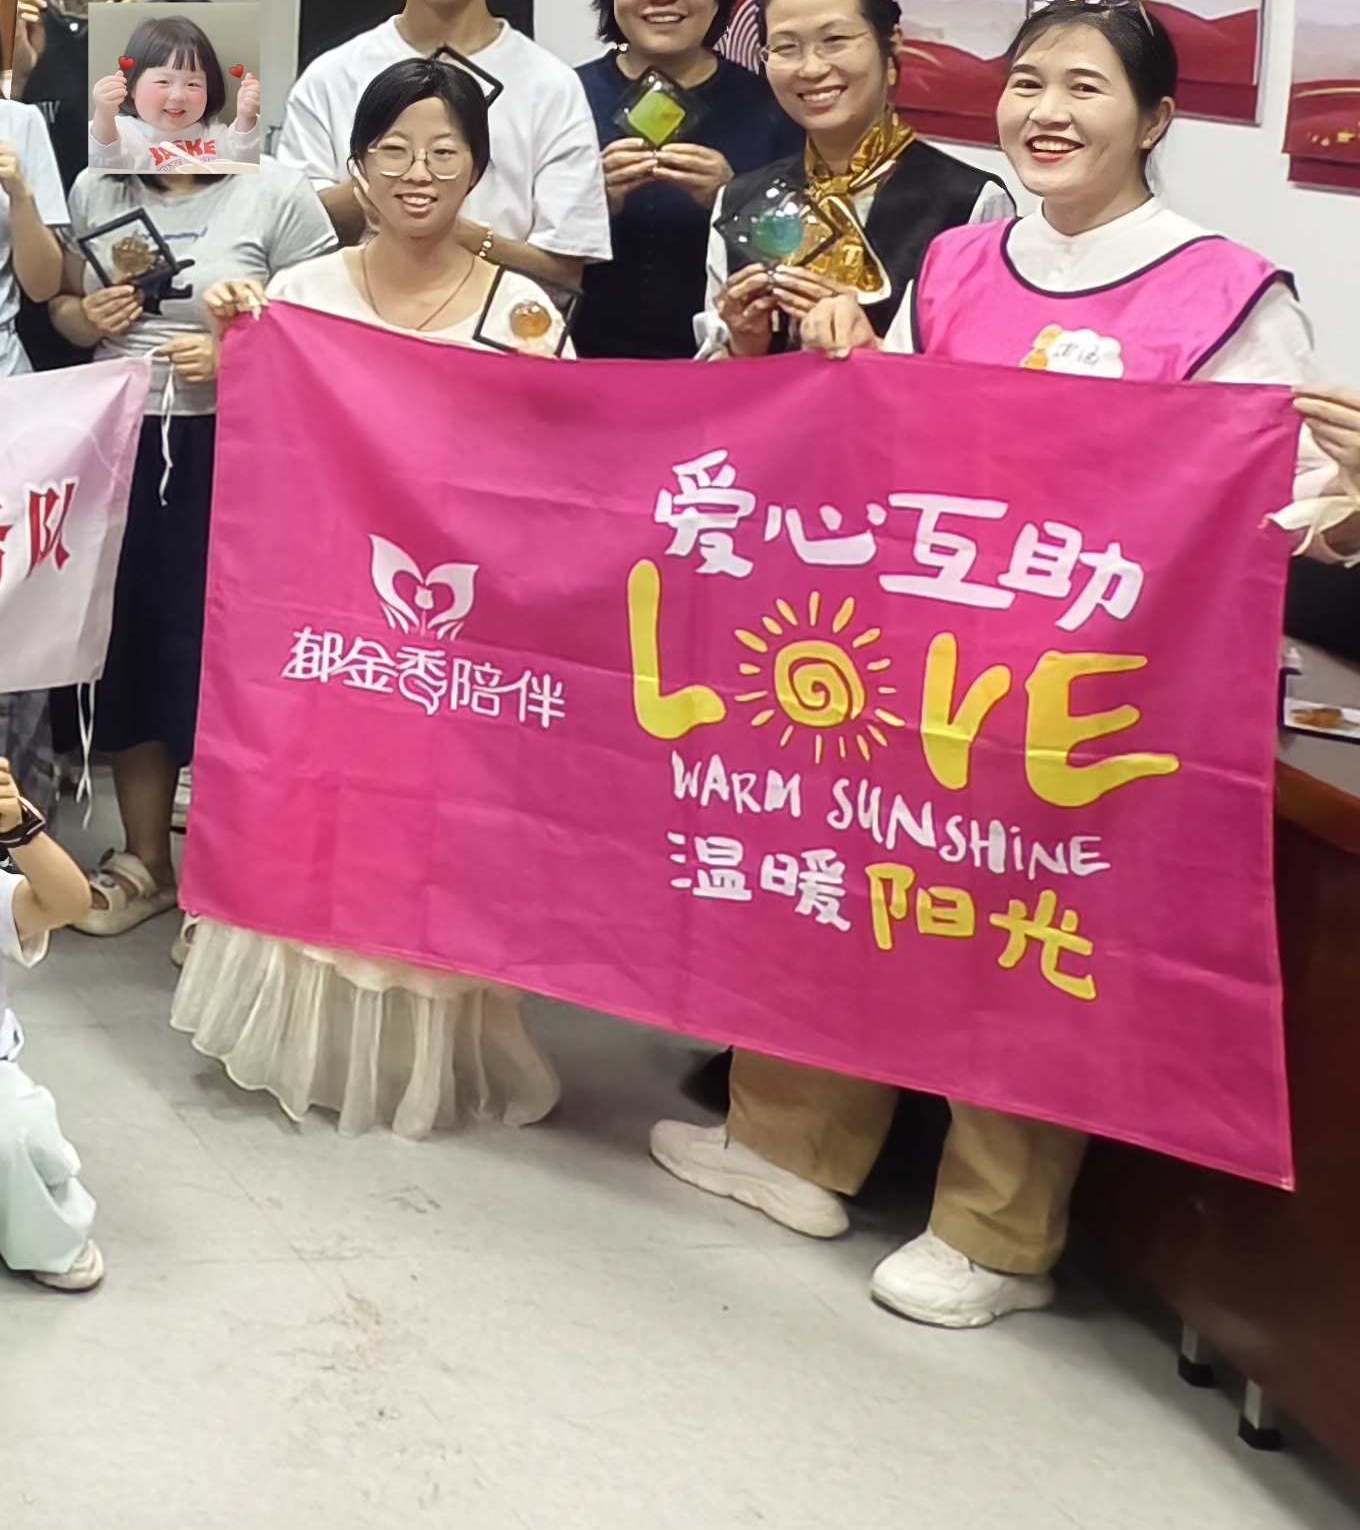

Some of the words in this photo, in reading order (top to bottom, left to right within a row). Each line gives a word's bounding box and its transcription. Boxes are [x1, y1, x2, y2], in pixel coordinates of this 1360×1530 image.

[655, 449, 1145, 631] 爱心互助
[282, 625, 567, 729] 郁金香陪伴
[627, 559, 1180, 808] LOVE
[671, 751, 802, 818] WARM
[667, 832, 1096, 1001] 温暖阳光
